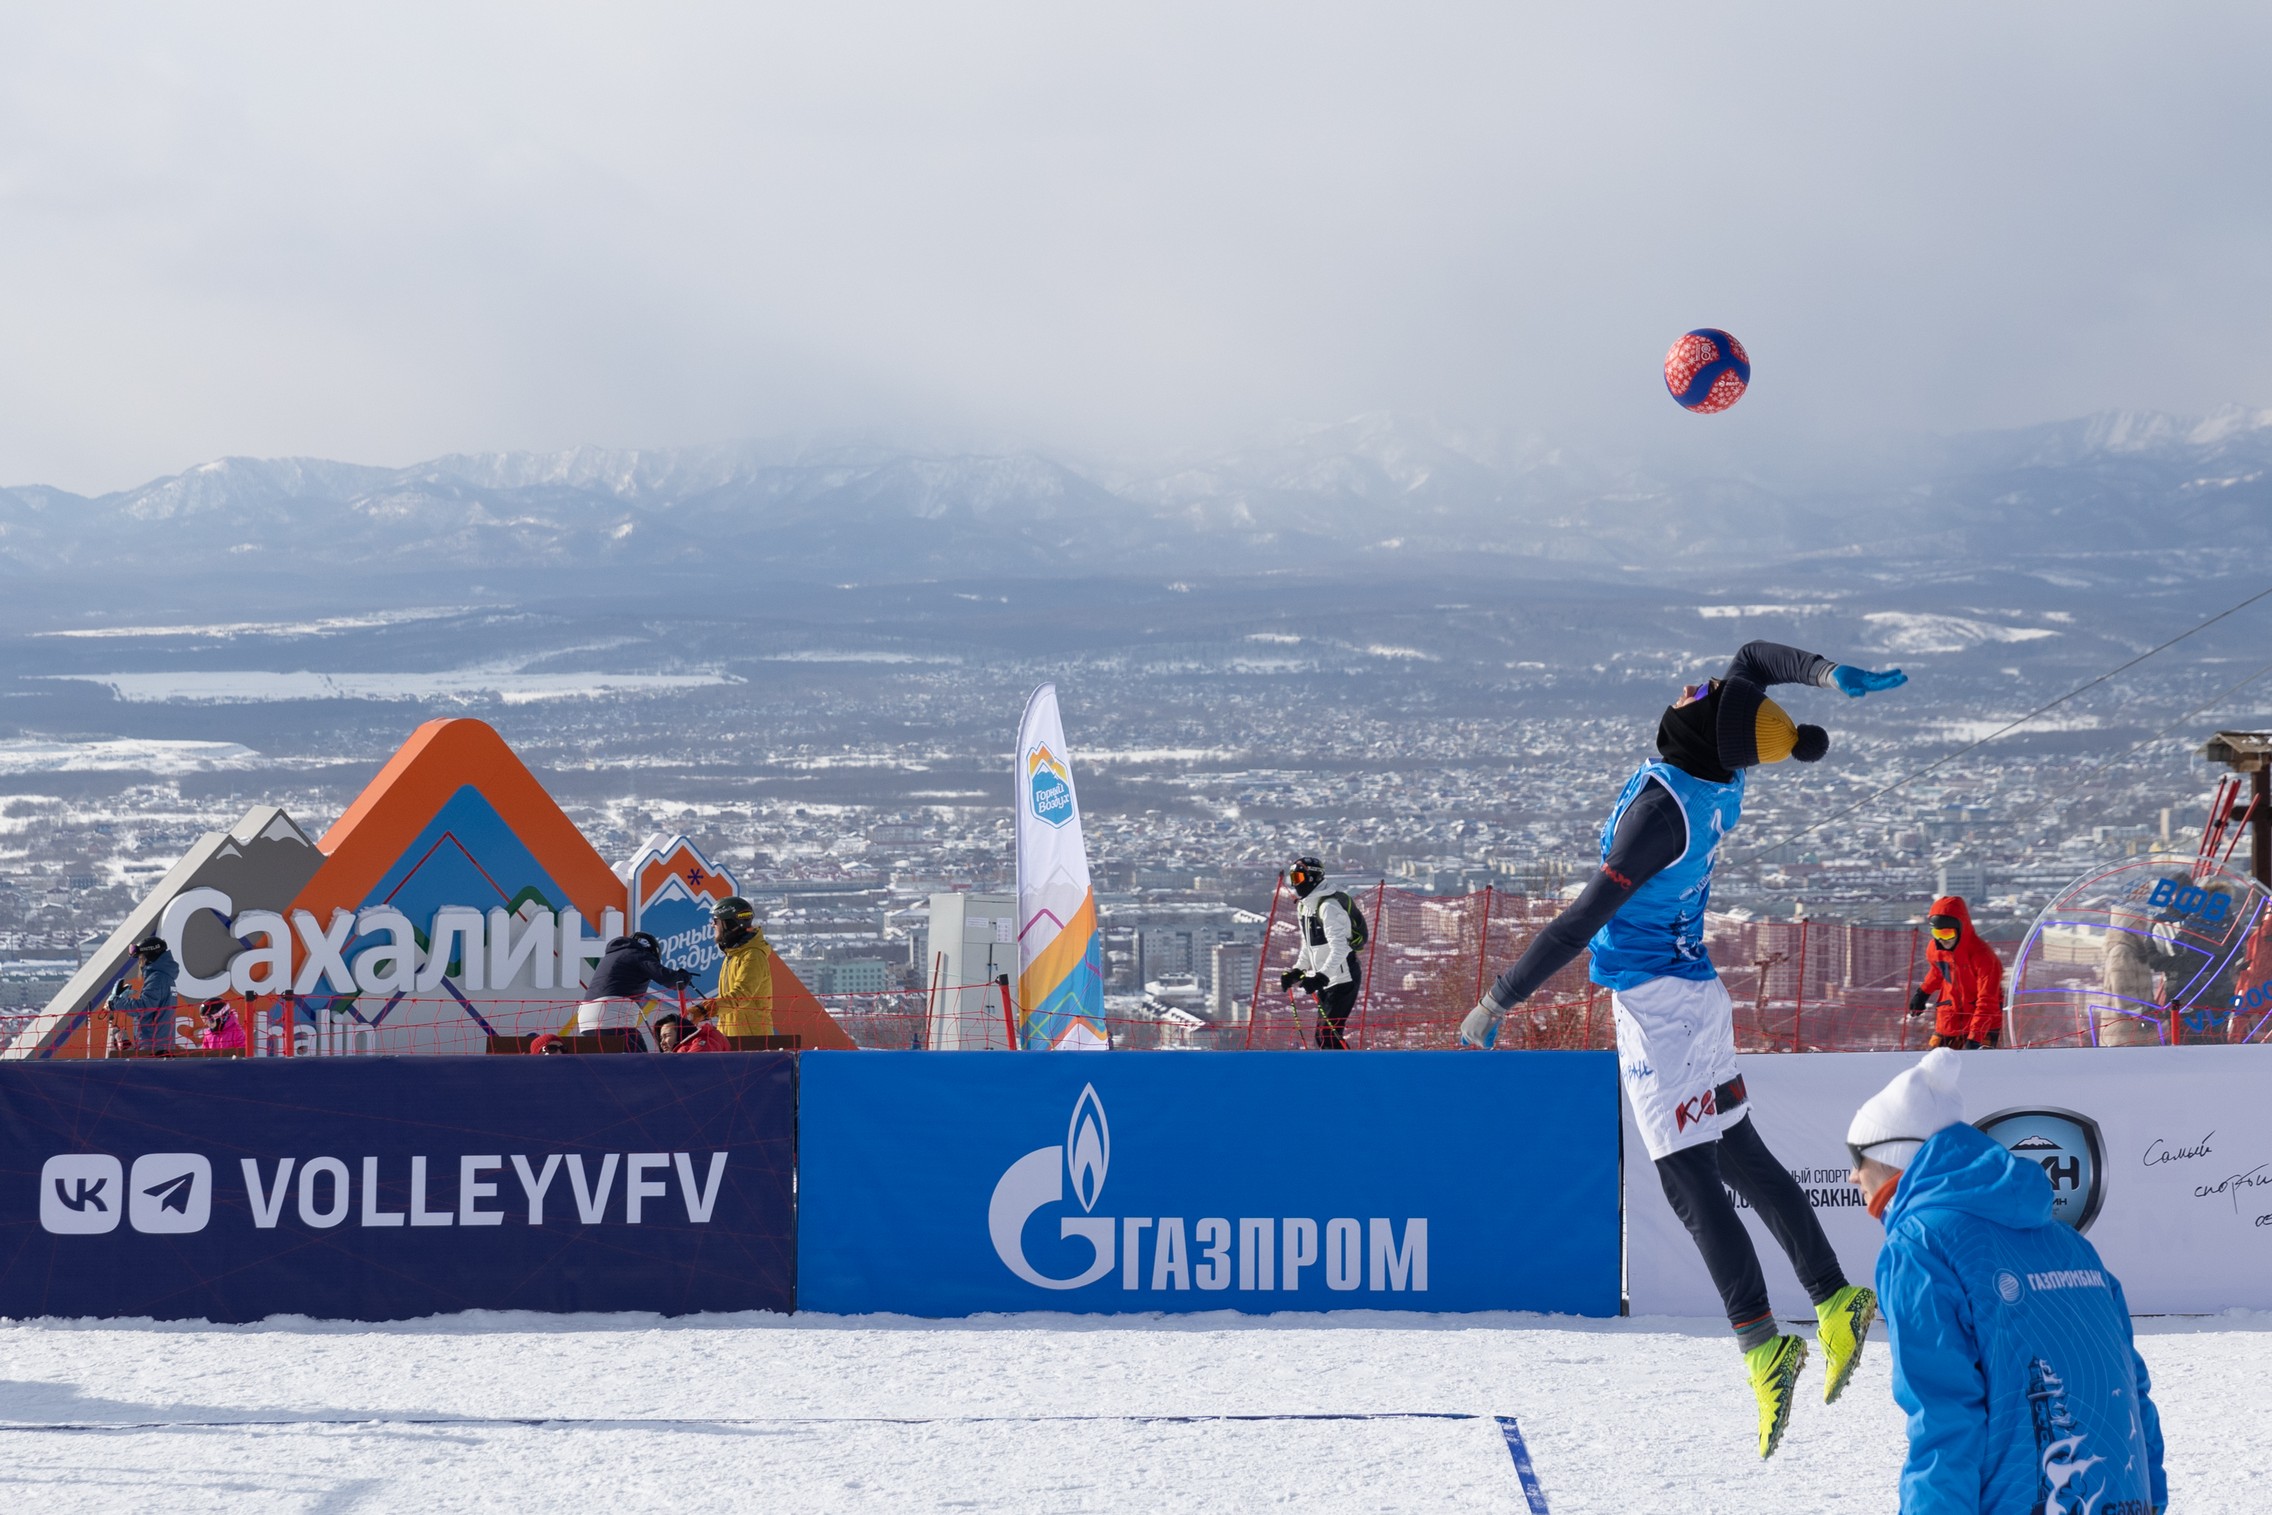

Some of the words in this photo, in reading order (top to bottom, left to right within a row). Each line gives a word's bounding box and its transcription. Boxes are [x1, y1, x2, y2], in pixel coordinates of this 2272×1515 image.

[2147, 878, 2232, 922] ВФВ
[158, 886, 625, 999] Сахалин
[656, 921, 716, 958] орный
[661, 944, 724, 971] оздух
[2143, 1130, 2216, 1166] Самый
[240, 1152, 729, 1229] VOLLEYVFV
[1813, 1169, 1850, 1184] СПОРТ
[1122, 1217, 1428, 1292] ГАЗПРОМ
[2027, 1269, 2106, 1292] ГАЗПРОМБАНК
